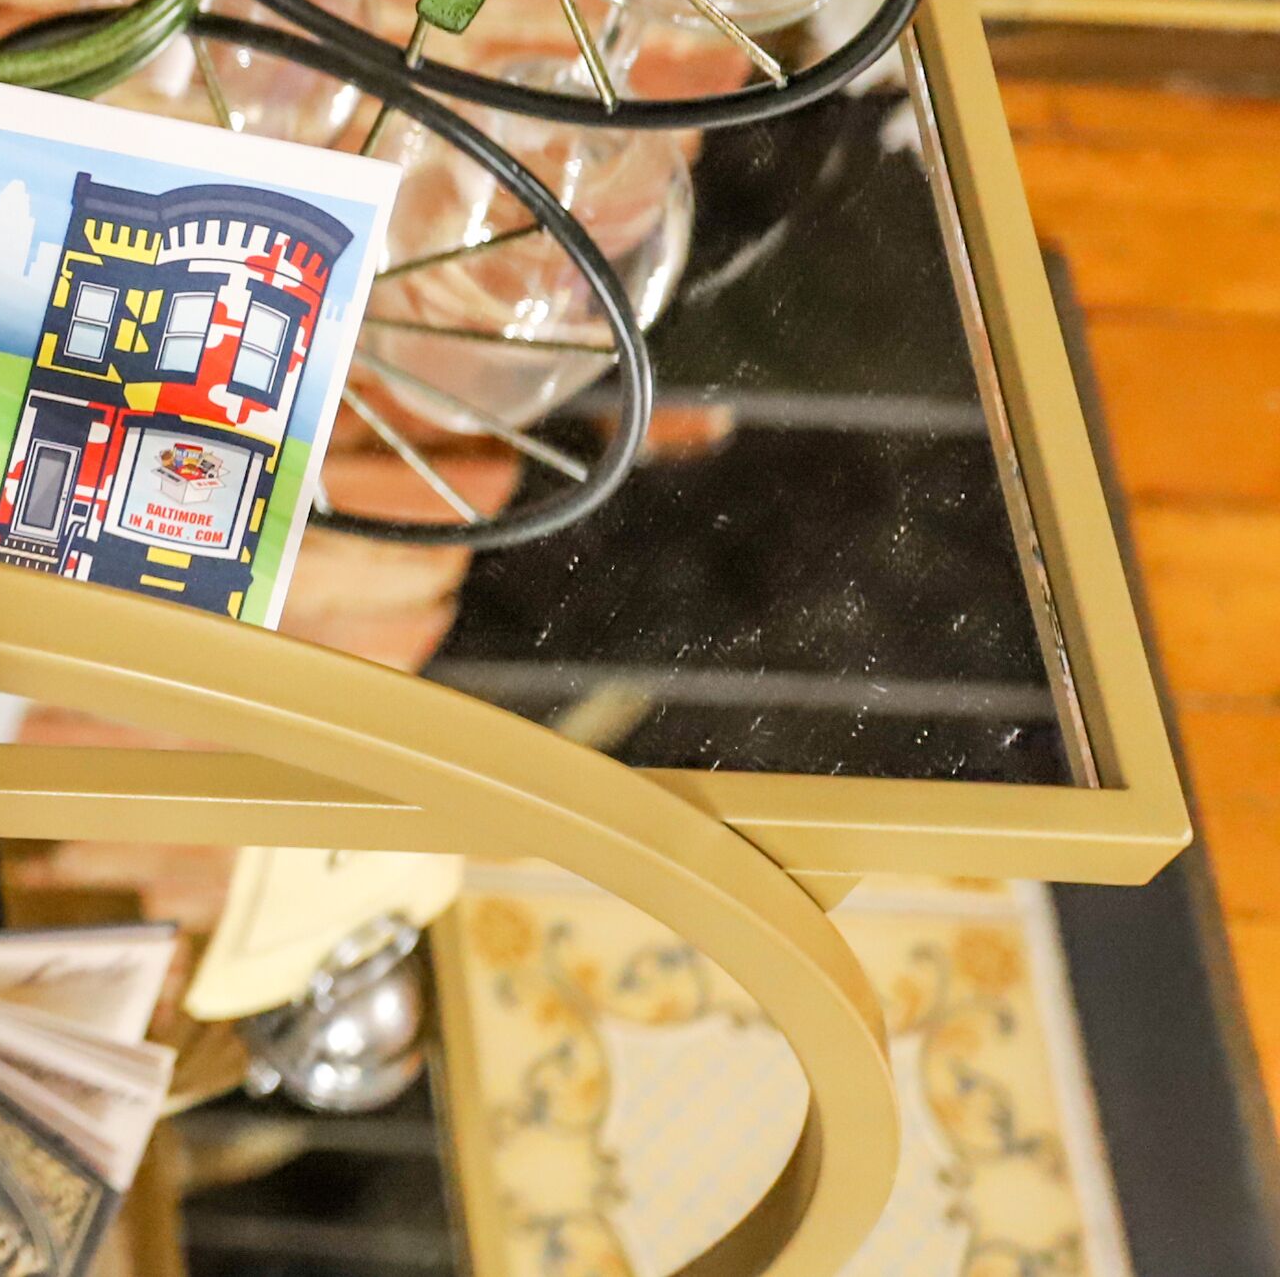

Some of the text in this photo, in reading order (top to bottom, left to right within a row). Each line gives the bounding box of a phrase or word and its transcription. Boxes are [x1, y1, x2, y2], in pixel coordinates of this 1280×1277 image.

[128, 513, 142, 527] IN
[145, 516, 154, 530] A
[157, 523, 182, 538] BOX
[194, 529, 224, 544] COM
[146, 502, 213, 527] BALTIMORE
